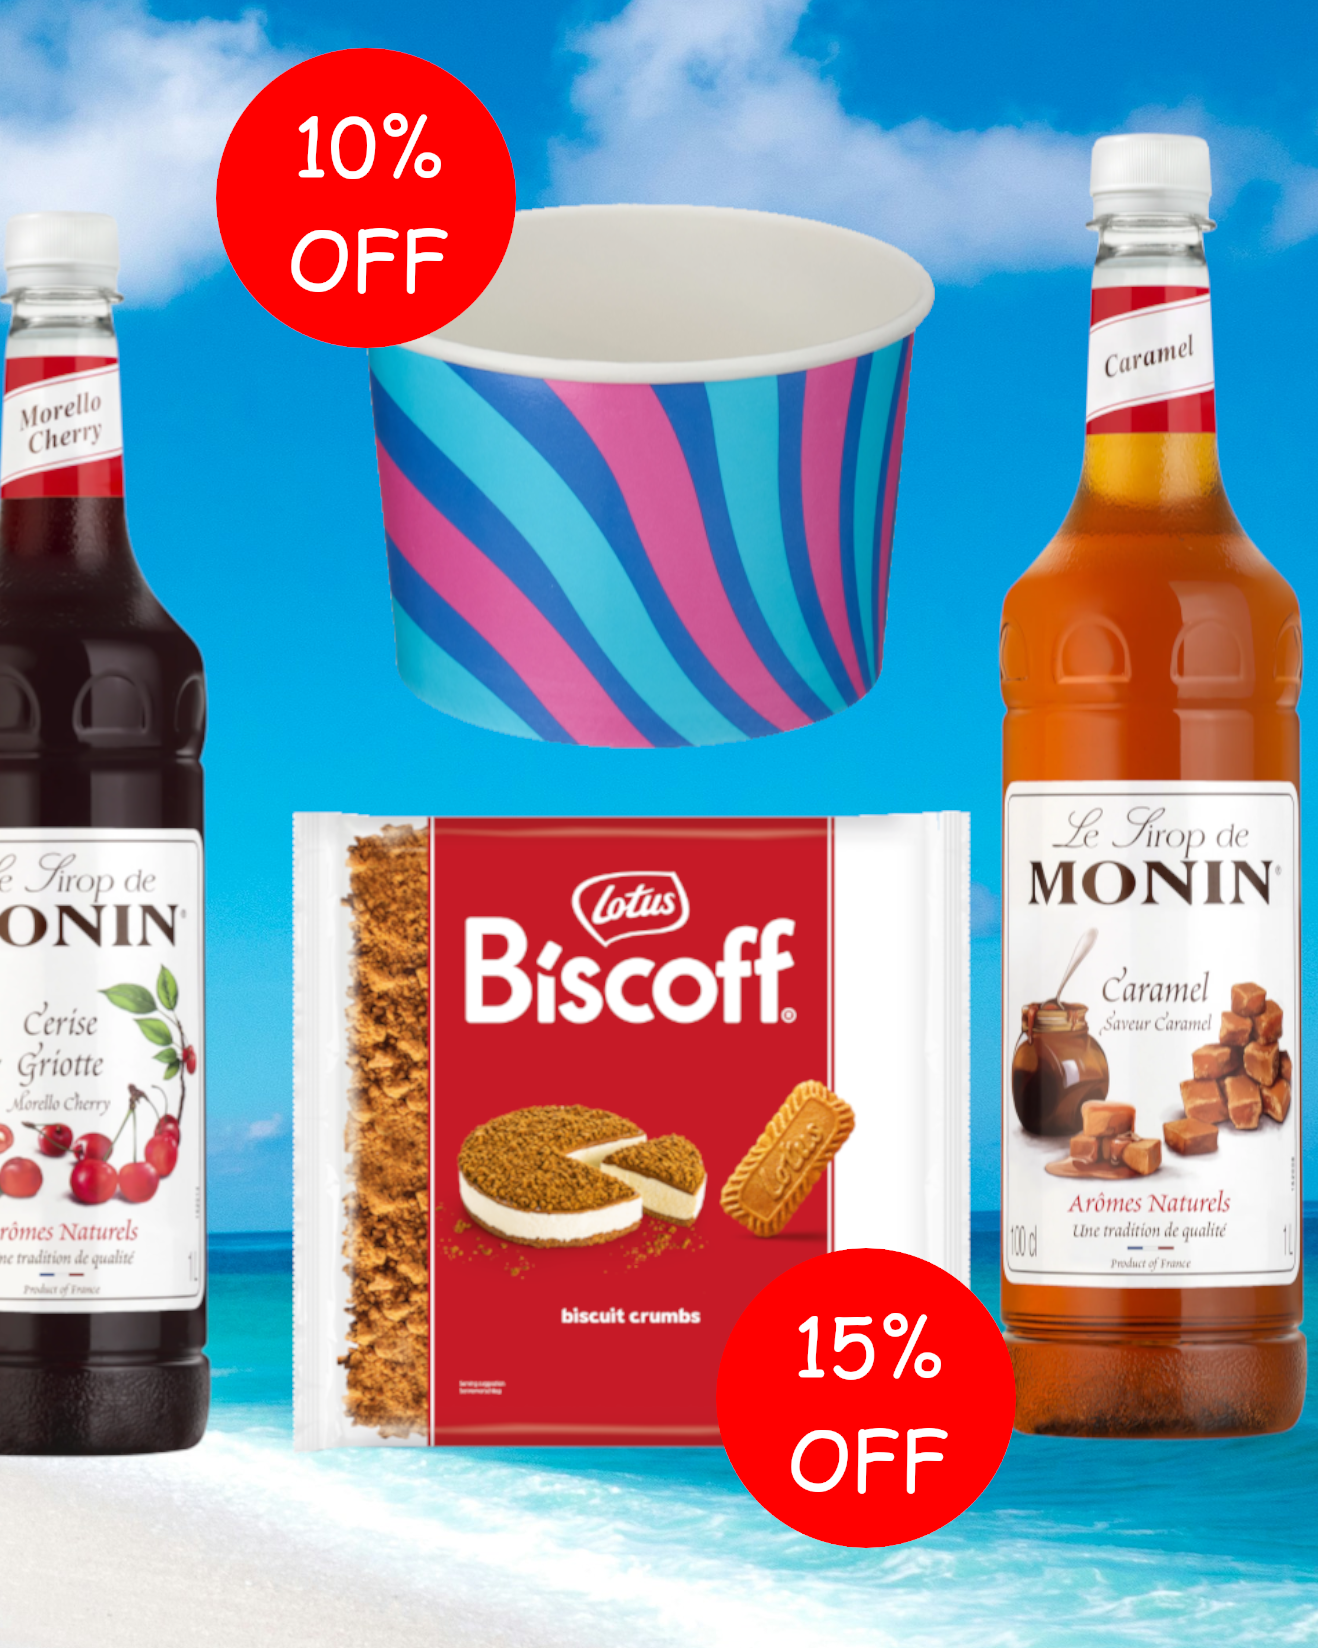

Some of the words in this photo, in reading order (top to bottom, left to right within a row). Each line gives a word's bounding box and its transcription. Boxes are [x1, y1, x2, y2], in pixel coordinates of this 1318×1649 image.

[1104, 333, 1194, 379] Caramel
[19, 391, 102, 432] Morello
[28, 423, 103, 454] Cherry
[1052, 807, 1103, 848] Le
[1112, 806, 1206, 858] Sirop
[1216, 823, 1249, 848] de
[25, 852, 115, 903] Sirop
[124, 869, 156, 893] de
[591, 884, 676, 925] Lotus
[1102, 966, 1210, 1003] Caramel
[23, 1001, 98, 1036] Cerise
[1099, 1010, 1151, 1036] Saveur
[1154, 1011, 1212, 1032] Caramel
[17, 1042, 104, 1087] Griotte
[6, 1089, 60, 1112] Morello
[63, 1091, 111, 1116] Cherry
[1067, 1192, 1142, 1213] Arômes
[1148, 1189, 1231, 1213] Naturels
[59, 1218, 139, 1241] Naturels
[1073, 1223, 1101, 1239] Une
[1103, 1221, 1161, 1239] tradition
[1164, 1221, 1179, 1239] de
[1182, 1222, 1227, 1244] qualité
[16, 1250, 72, 1266] tradition
[74, 1250, 90, 1266] de
[91, 1250, 135, 1270] qualité
[1110, 1258, 1146, 1269] Product
[1148, 1257, 1159, 1272] of
[1161, 1258, 1191, 1269] France
[23, 1284, 53, 1295] Product
[55, 1284, 68, 1298] of
[71, 1284, 101, 1295] France
[561, 1307, 625, 1324] biscuit
[628, 1307, 701, 1324] crumbs
